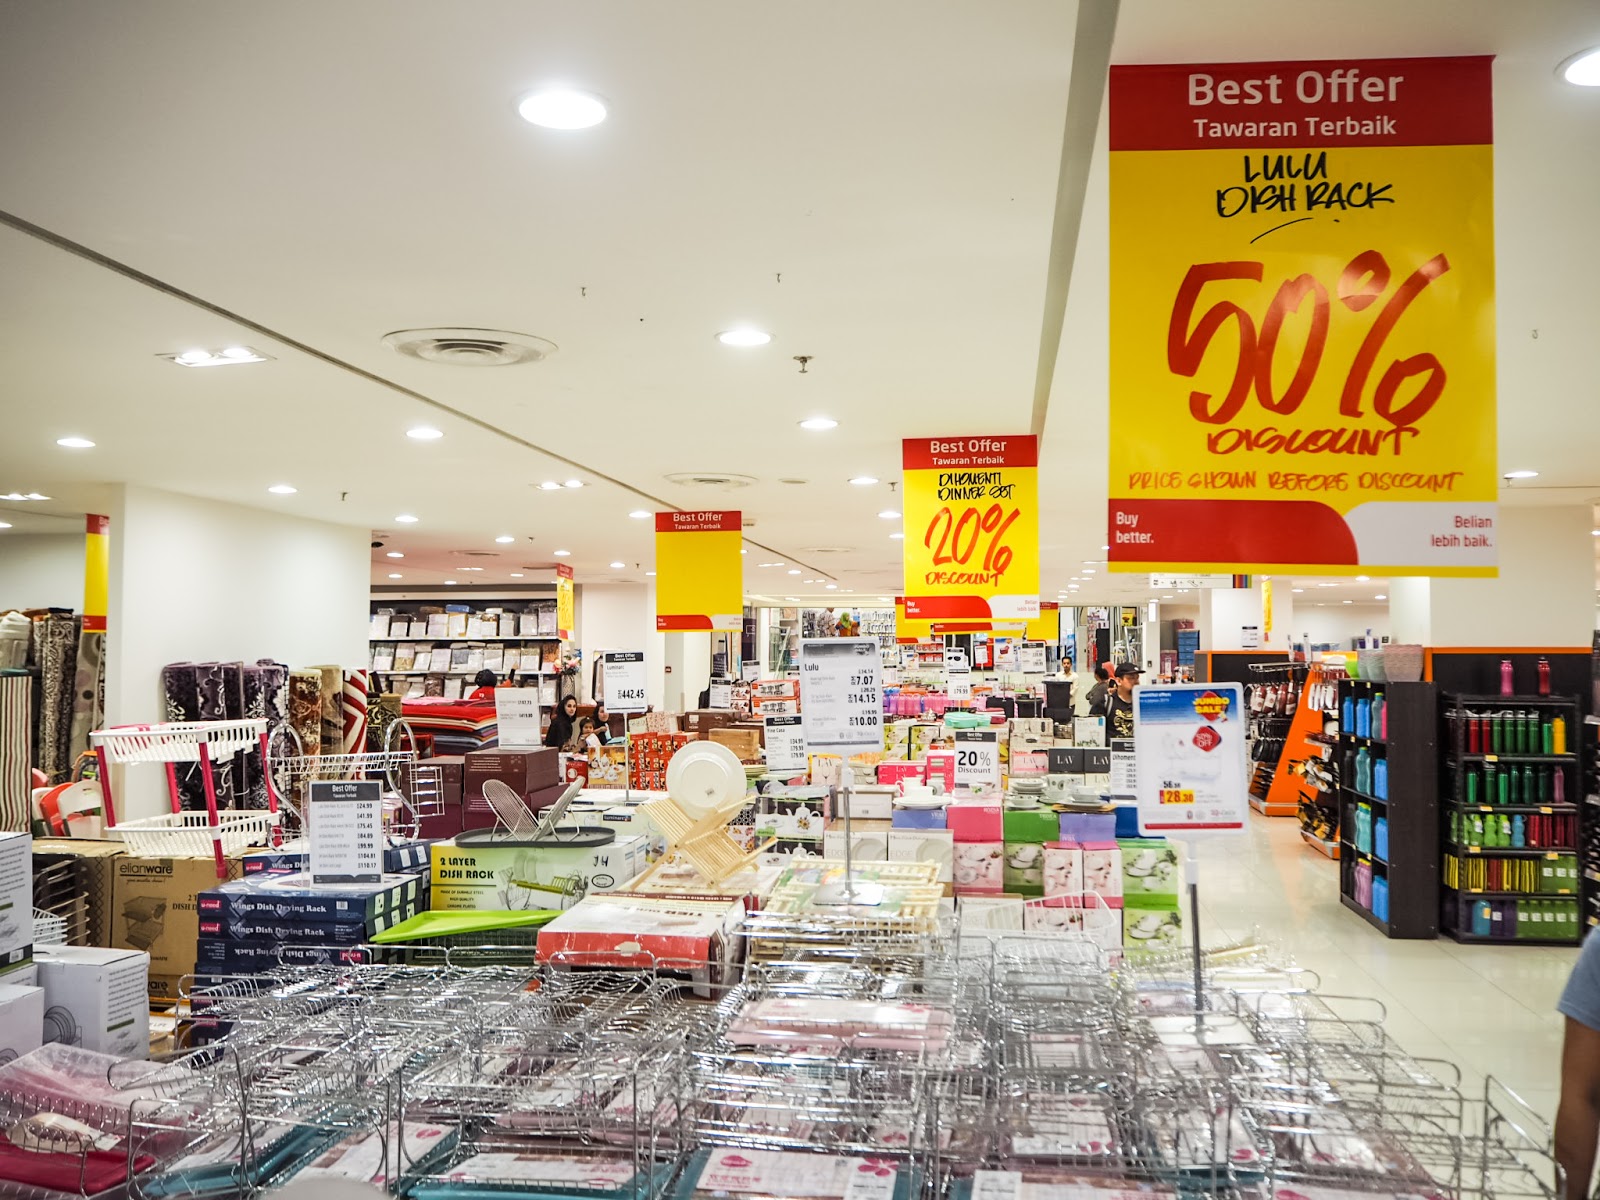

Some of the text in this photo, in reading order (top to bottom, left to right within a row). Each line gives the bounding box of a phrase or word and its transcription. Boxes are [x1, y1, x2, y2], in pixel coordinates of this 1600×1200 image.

[1188, 69, 1404, 106] Best Offer
[1194, 115, 1397, 138] Tawaran Terbaik
[1244, 151, 1328, 183] LULU
[1216, 181, 1395, 218] DISH RACK
[1168, 249, 1450, 428] 50%
[930, 439, 1007, 454] Best Offer
[1207, 426, 1420, 456] DISCOUNT
[932, 455, 1005, 465] Tawaran Terbaik
[1129, 470, 1464, 492] PRICE SHOWN BEFORE DISCOUNT
[938, 485, 986, 501] DINNER
[673, 512, 722, 522] Best Offer
[1116, 512, 1139, 527] Buy
[1454, 515, 1492, 529] Belian
[925, 503, 1021, 575] 20%
[1116, 530, 1155, 544] better.
[1431, 533, 1493, 548] lebih baik.
[925, 571, 1004, 587] DISCOUNT
[805, 663, 819, 671] Lulu
[857, 675, 873, 685] 7.07
[622, 689, 645, 699] 442.45
[854, 694, 876, 703] 14.15
[1193, 697, 1230, 706] JUMBO
[1195, 705, 1223, 714] SALE
[855, 716, 877, 726] 10.00
[1057, 755, 1073, 765] LAV
[1093, 756, 1109, 765] LAV
[332, 784, 357, 792] Best Offer
[1167, 790, 1194, 803] 28.30
[440, 857, 476, 866] 2 LAYER
[120, 863, 173, 874] elianware
[440, 870, 494, 879] DISH RACK
[231, 902, 254, 911] Wings
[257, 902, 275, 911] Dish
[276, 903, 305, 913] Drying
[306, 904, 327, 913] Rack
[230, 925, 254, 934] Wings
[256, 926, 273, 934] Dish
[275, 926, 303, 936] Drying
[304, 927, 325, 936] Rack
[235, 948, 254, 956] Rack
[286, 950, 304, 958] Dish
[305, 950, 330, 958] Wings
